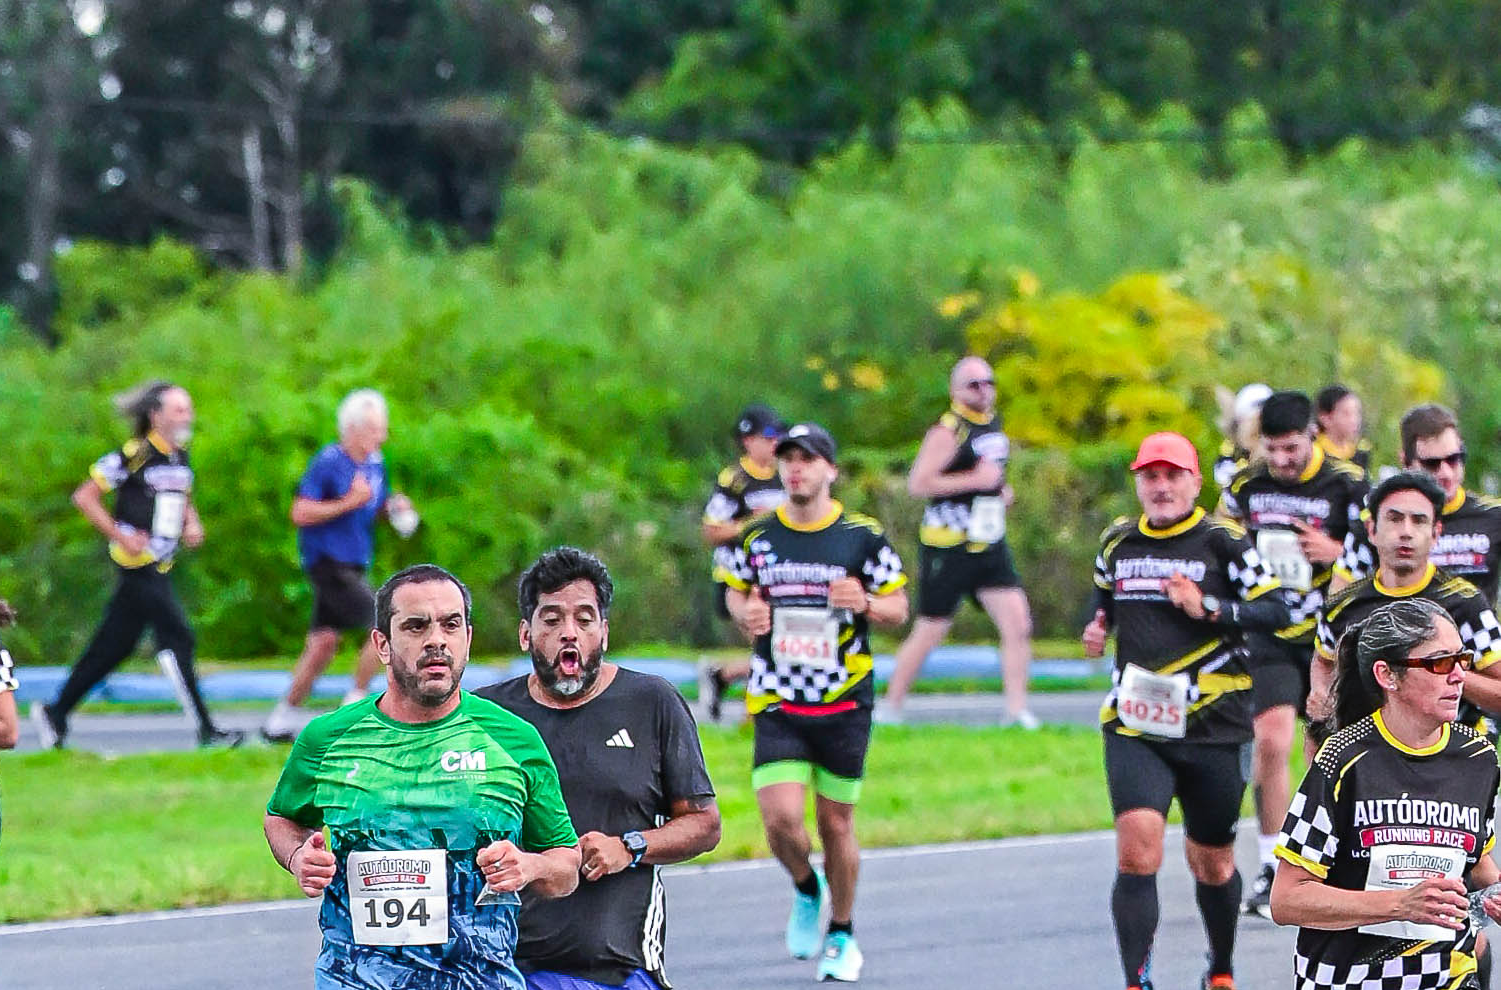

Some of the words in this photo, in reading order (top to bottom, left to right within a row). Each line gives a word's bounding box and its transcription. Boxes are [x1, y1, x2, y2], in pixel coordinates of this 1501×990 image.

[1120, 699, 1180, 725] 4025
[441, 751, 486, 771] CM
[1354, 792, 1480, 833] AUTÓDROMO
[1373, 828, 1431, 844] RUNNING
[1433, 830, 1466, 848] RACE
[358, 856, 431, 877] AUTÓDROMO
[1385, 851, 1454, 873] AUTÓDROMO
[364, 898, 431, 928] 194
